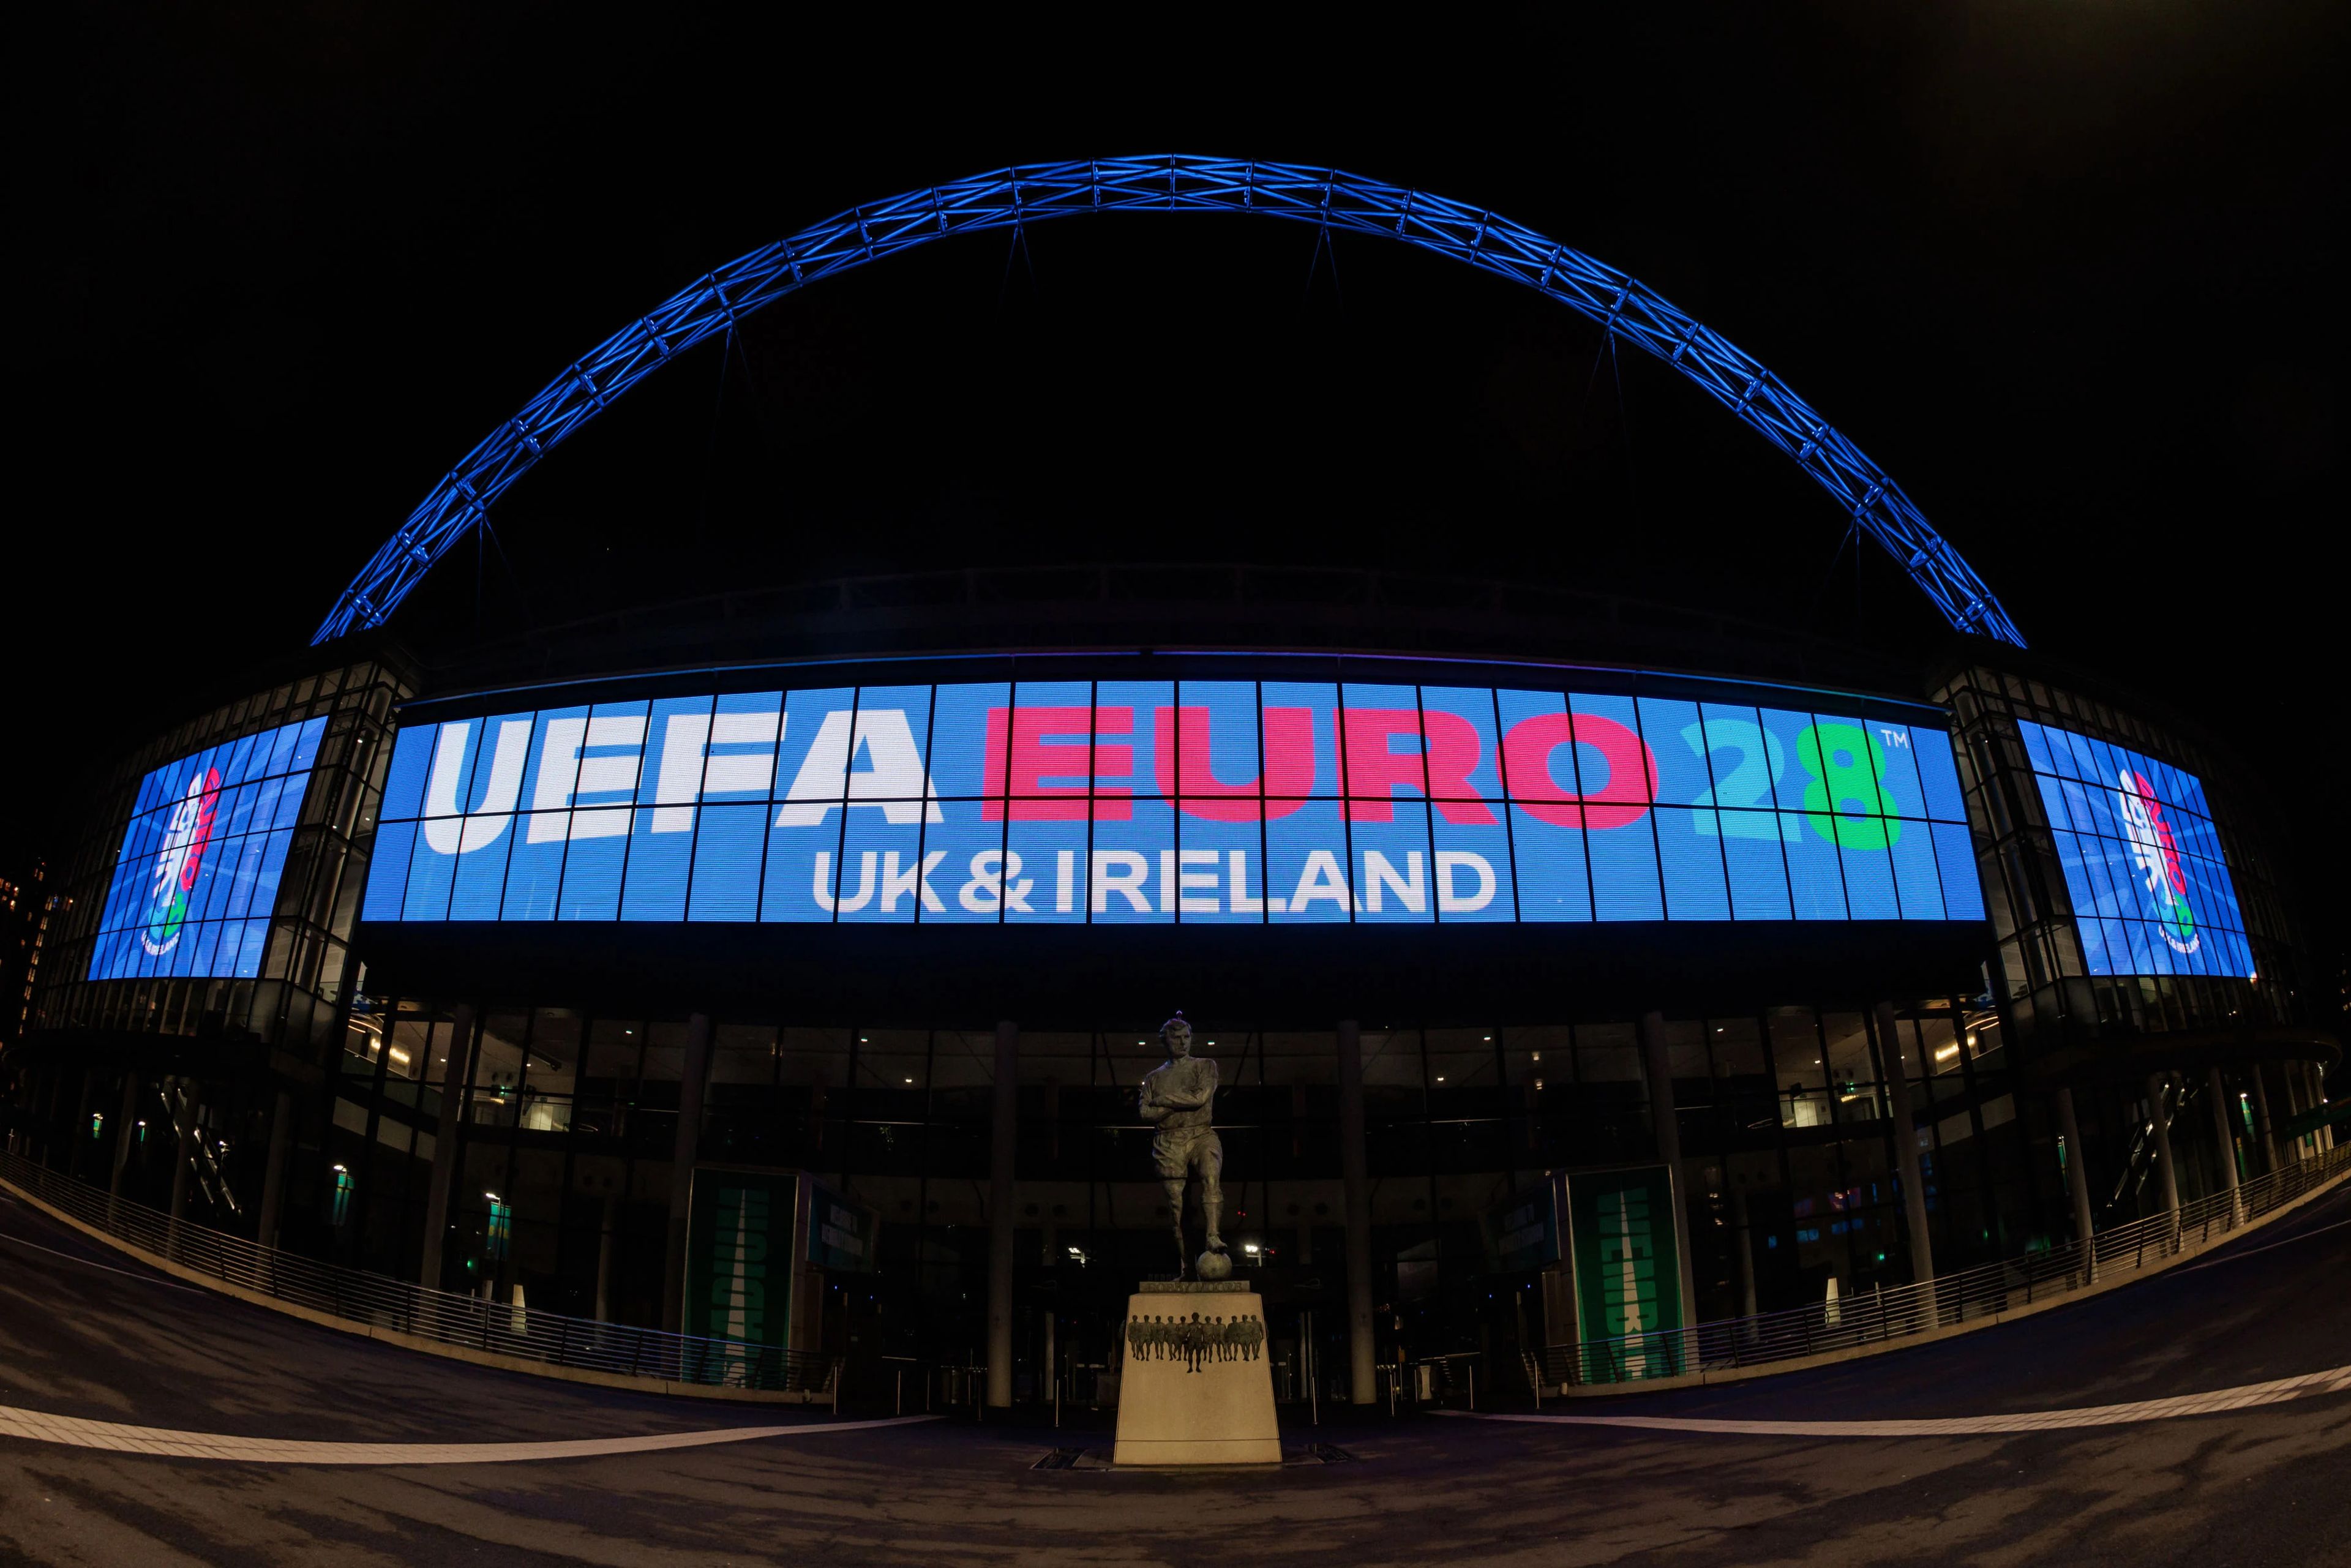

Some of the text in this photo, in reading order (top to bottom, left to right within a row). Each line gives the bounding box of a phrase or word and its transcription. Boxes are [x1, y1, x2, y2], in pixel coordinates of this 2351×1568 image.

[181, 767, 220, 891] EURO
[424, 706, 1909, 855] UEFA EURO 28 TM
[2133, 771, 2187, 895] EURO
[812, 849, 1496, 914] UK & IRELAND
[1597, 1186, 1663, 1382] WEMBLE
